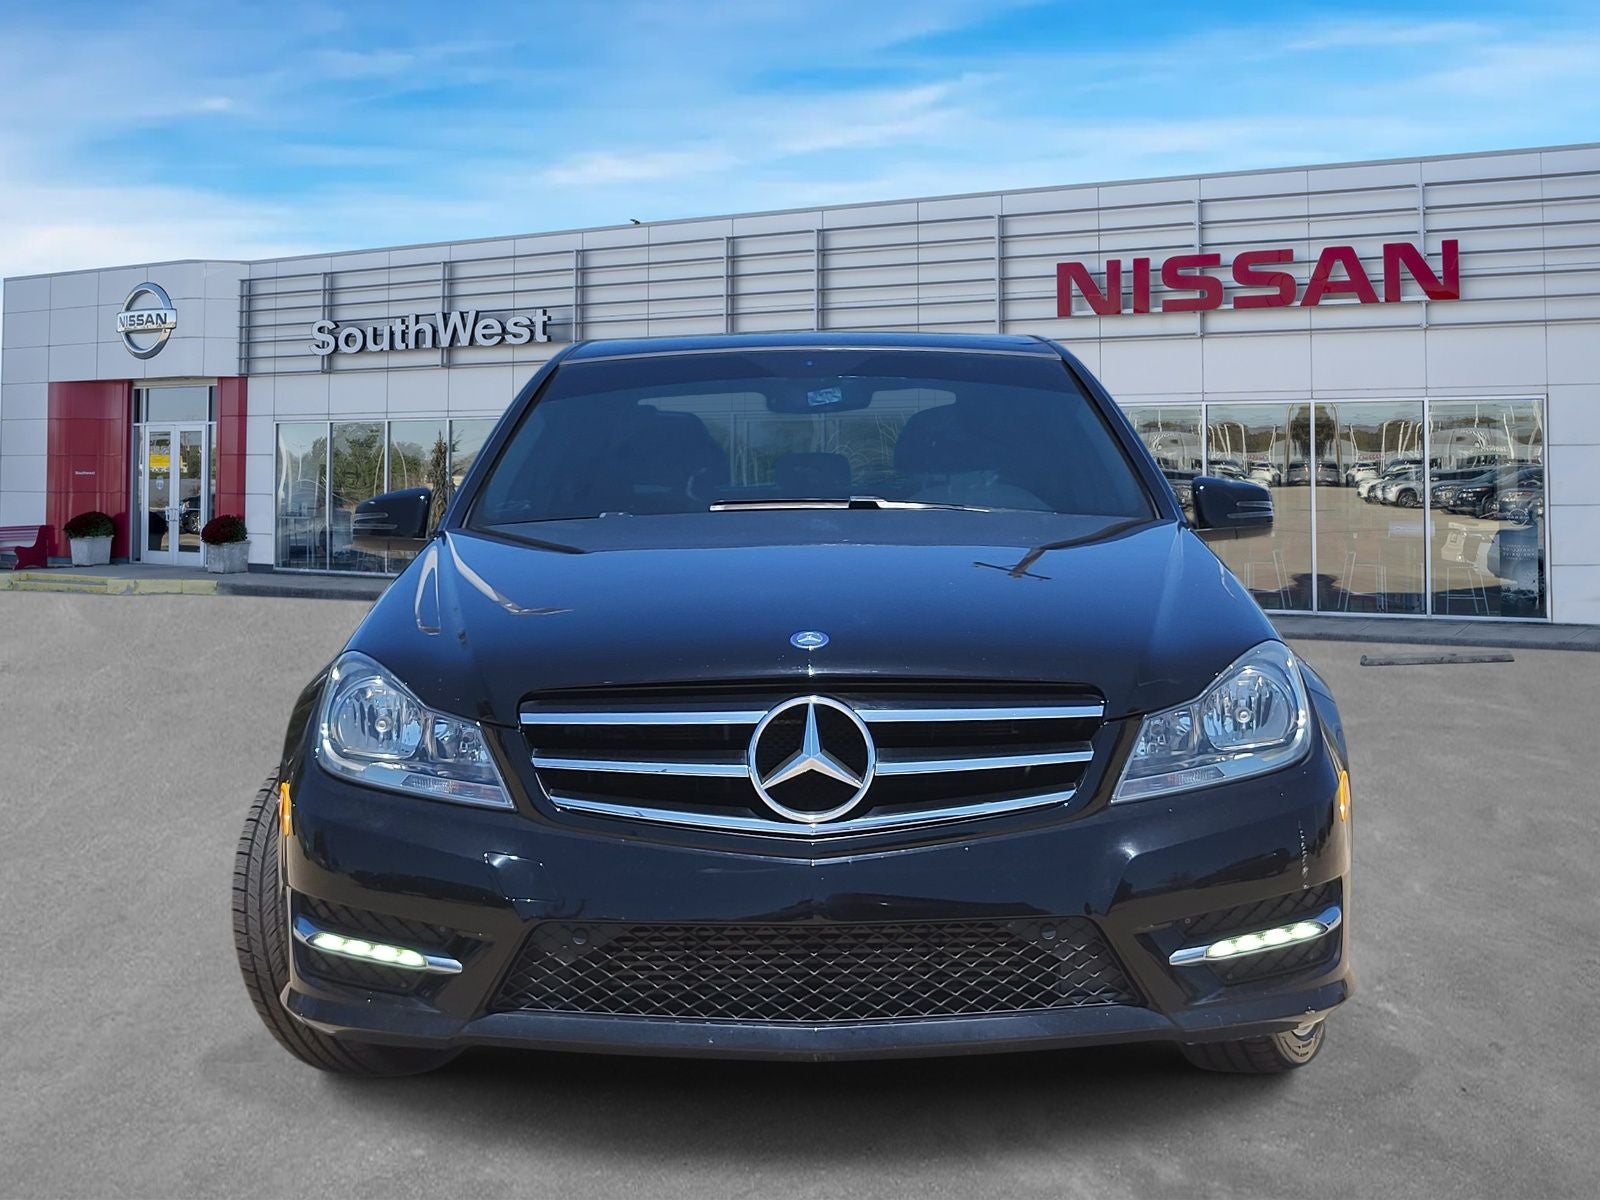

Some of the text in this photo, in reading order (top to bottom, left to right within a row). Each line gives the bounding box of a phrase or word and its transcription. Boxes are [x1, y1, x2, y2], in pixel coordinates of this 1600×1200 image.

[1056, 239, 1461, 318] NISSAN
[119, 312, 167, 328] NISSAN
[309, 308, 551, 356] SouthWest
